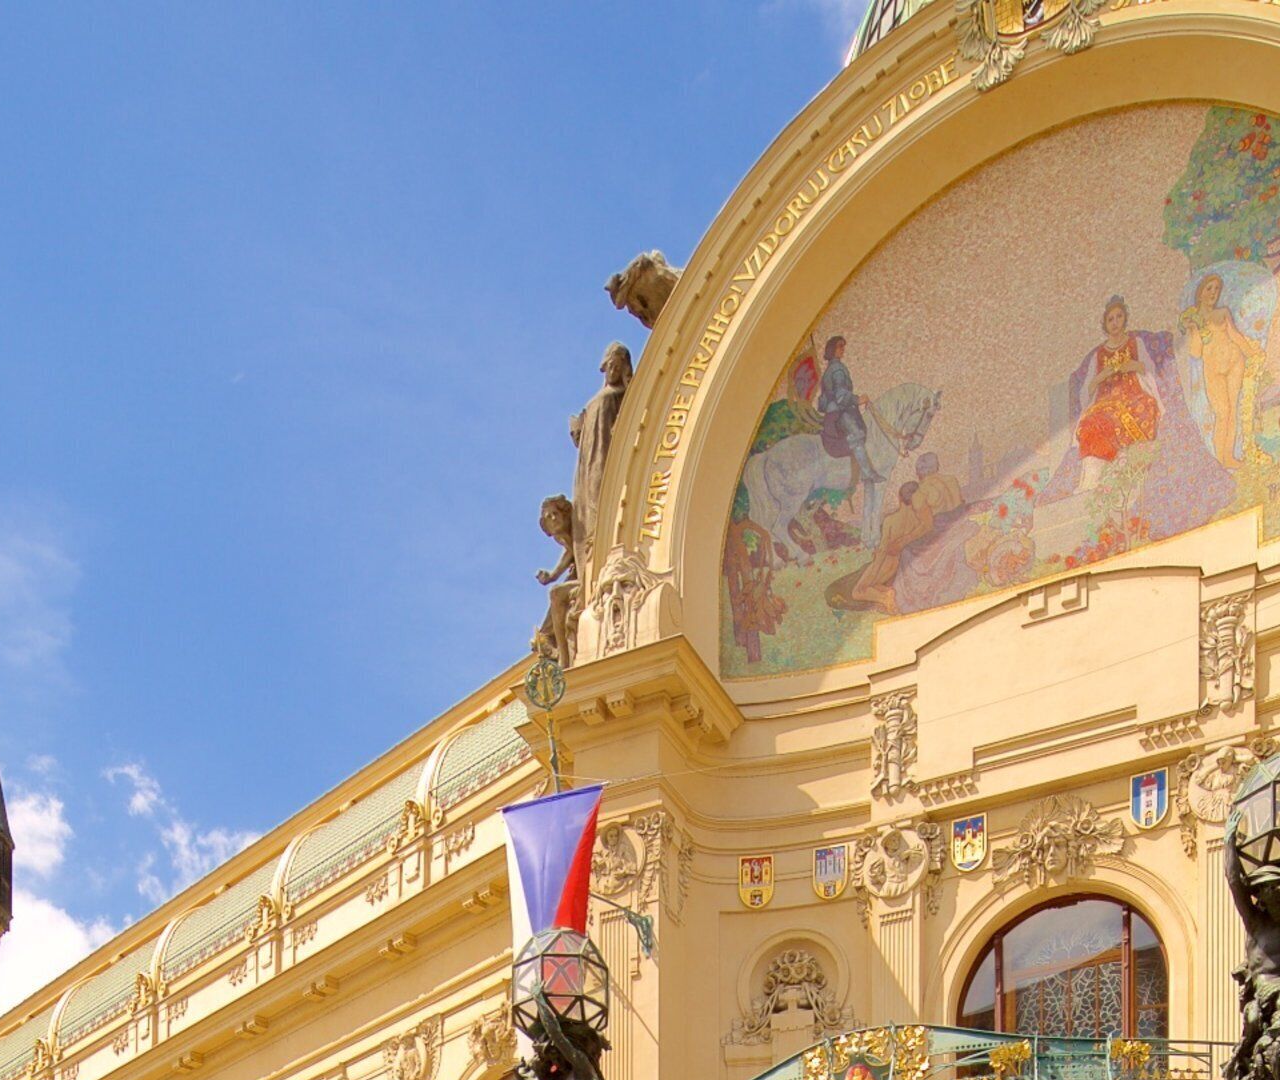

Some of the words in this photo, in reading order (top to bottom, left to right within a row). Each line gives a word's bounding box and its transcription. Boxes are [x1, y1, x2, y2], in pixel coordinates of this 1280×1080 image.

[638, 470, 672, 543] ZDAR
[680, 283, 745, 389] PRAHO!
[732, 169, 830, 281] VZDORUJ
